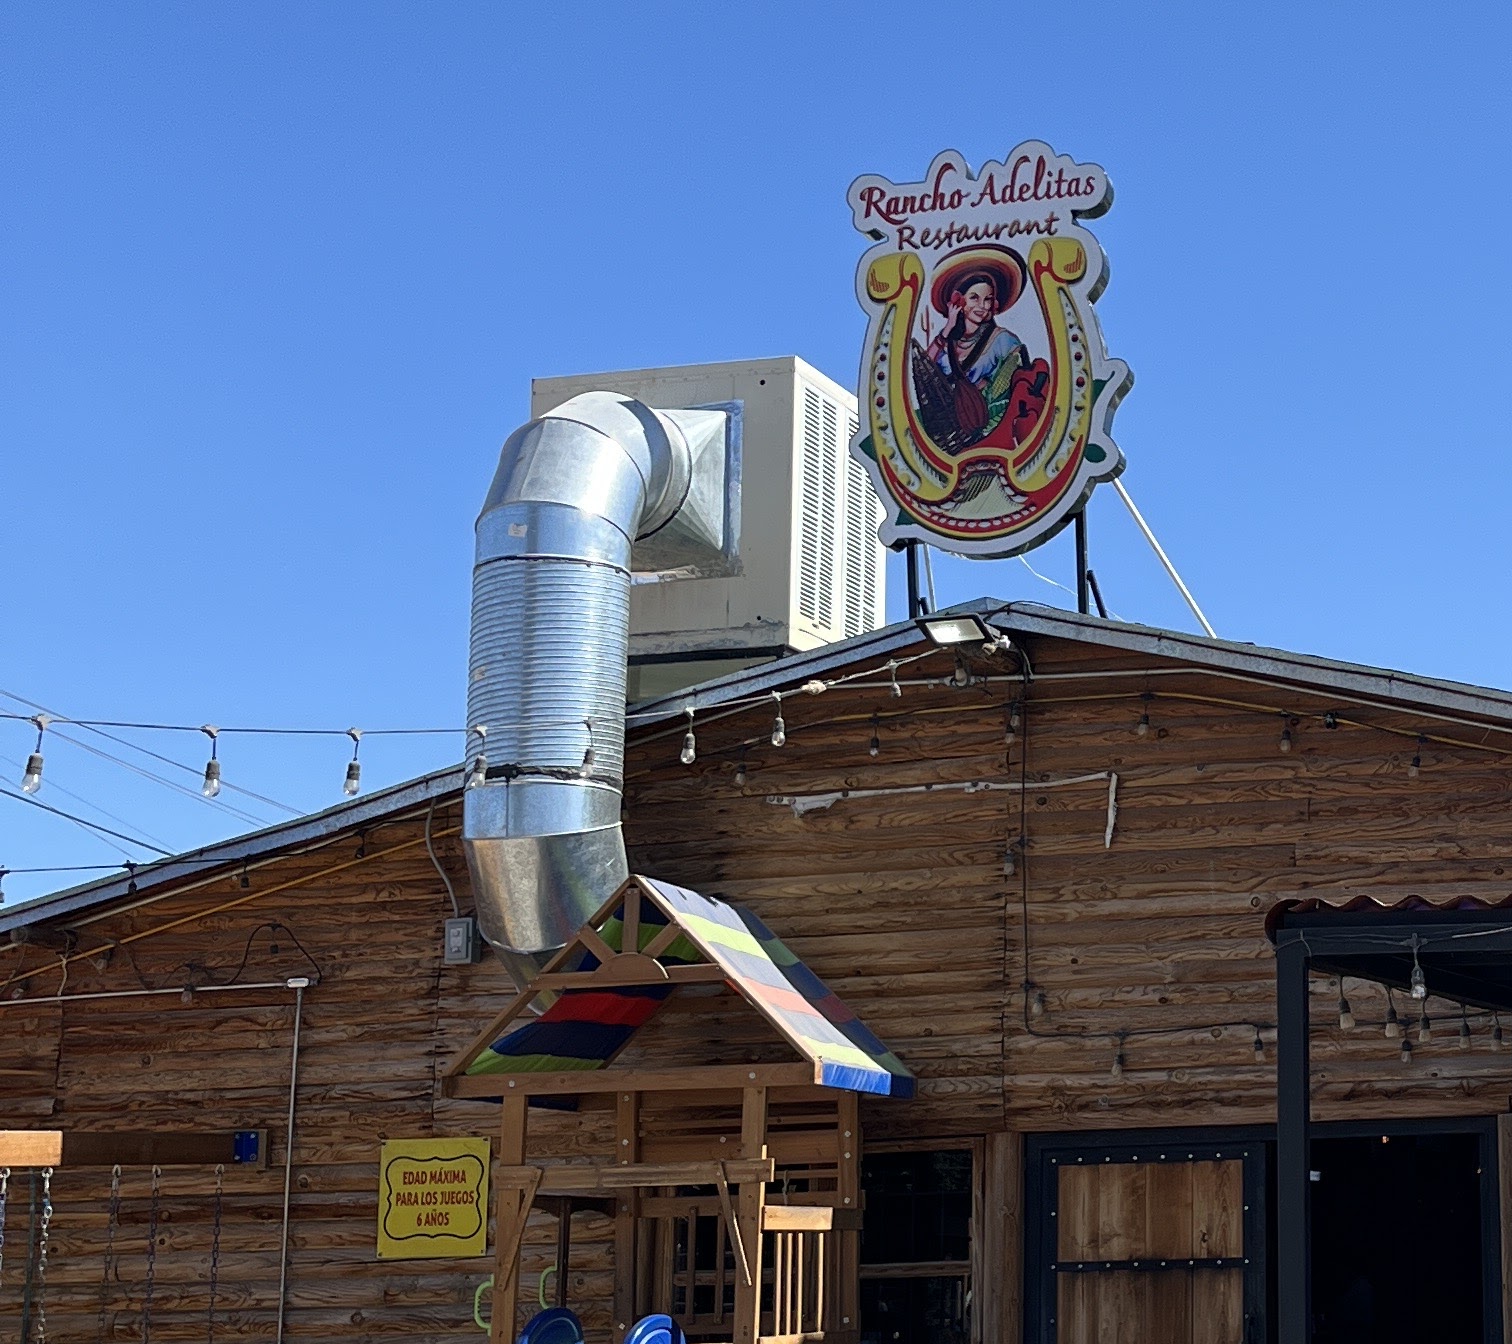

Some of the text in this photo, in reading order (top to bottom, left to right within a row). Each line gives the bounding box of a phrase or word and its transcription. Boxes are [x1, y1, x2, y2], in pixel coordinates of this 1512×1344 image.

[859, 155, 1096, 225] Rancho Adelitas
[898, 210, 1060, 251] Restaurant
[403, 1167, 466, 1185] EDAD MÁXIMA
[396, 1191, 475, 1206] PARA LOS JUEGOS
[416, 1209, 449, 1227] 6 AÑOS
